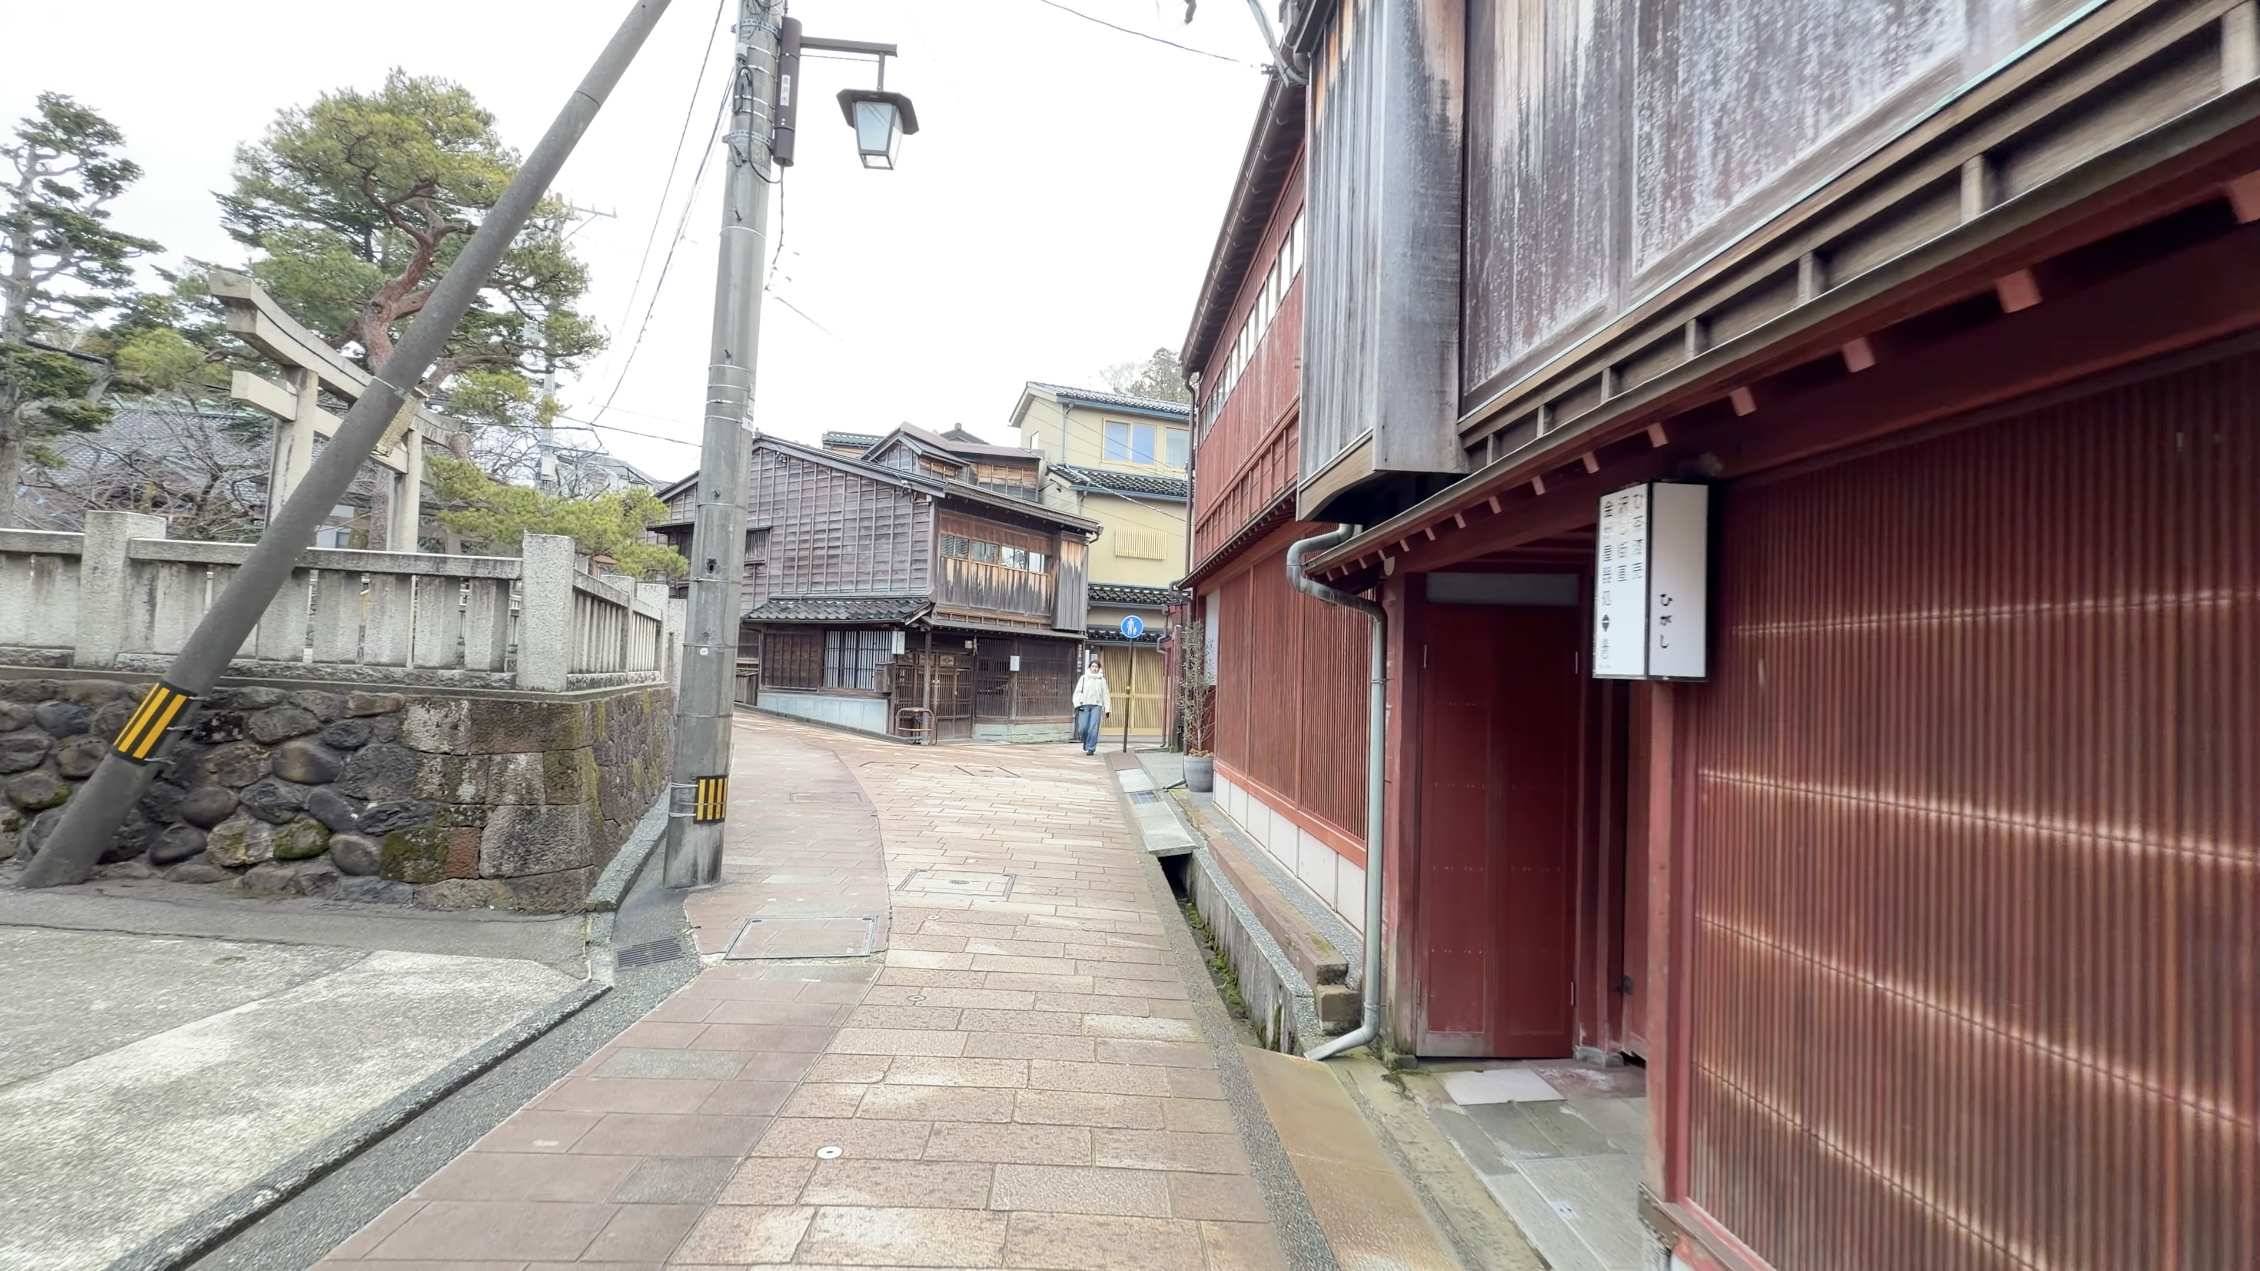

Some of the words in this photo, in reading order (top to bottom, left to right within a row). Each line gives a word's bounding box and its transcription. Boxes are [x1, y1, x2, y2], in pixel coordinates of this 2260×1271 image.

[781, 77, 789, 103] 金沢市
[1660, 593, 1673, 649] ひがし
